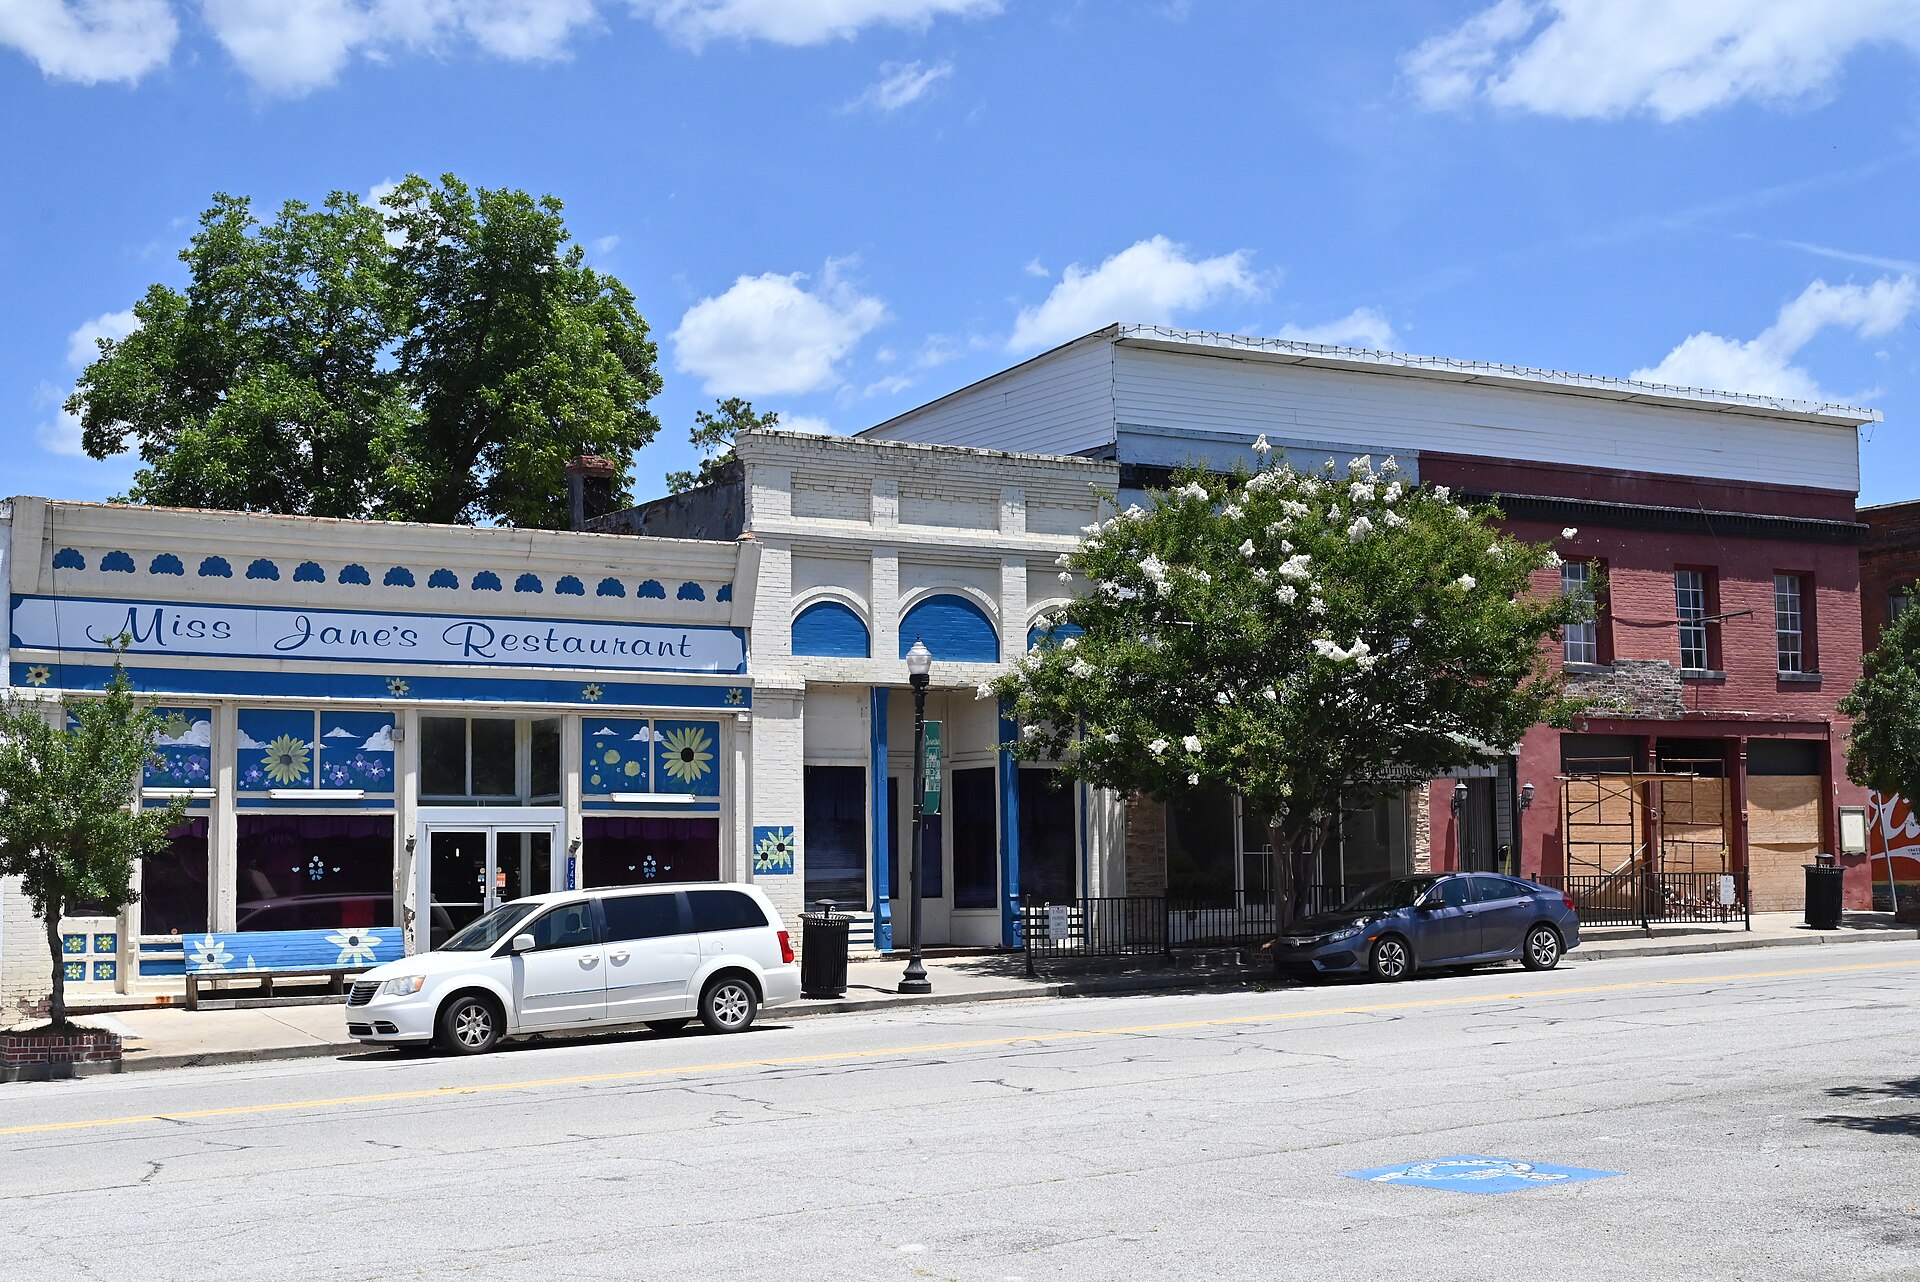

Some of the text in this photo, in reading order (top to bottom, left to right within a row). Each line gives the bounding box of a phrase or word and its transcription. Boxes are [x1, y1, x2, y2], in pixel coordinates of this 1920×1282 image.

[86, 606, 692, 658] Miss Jane's Restaurant
[264, 833, 295, 846] OPEN
